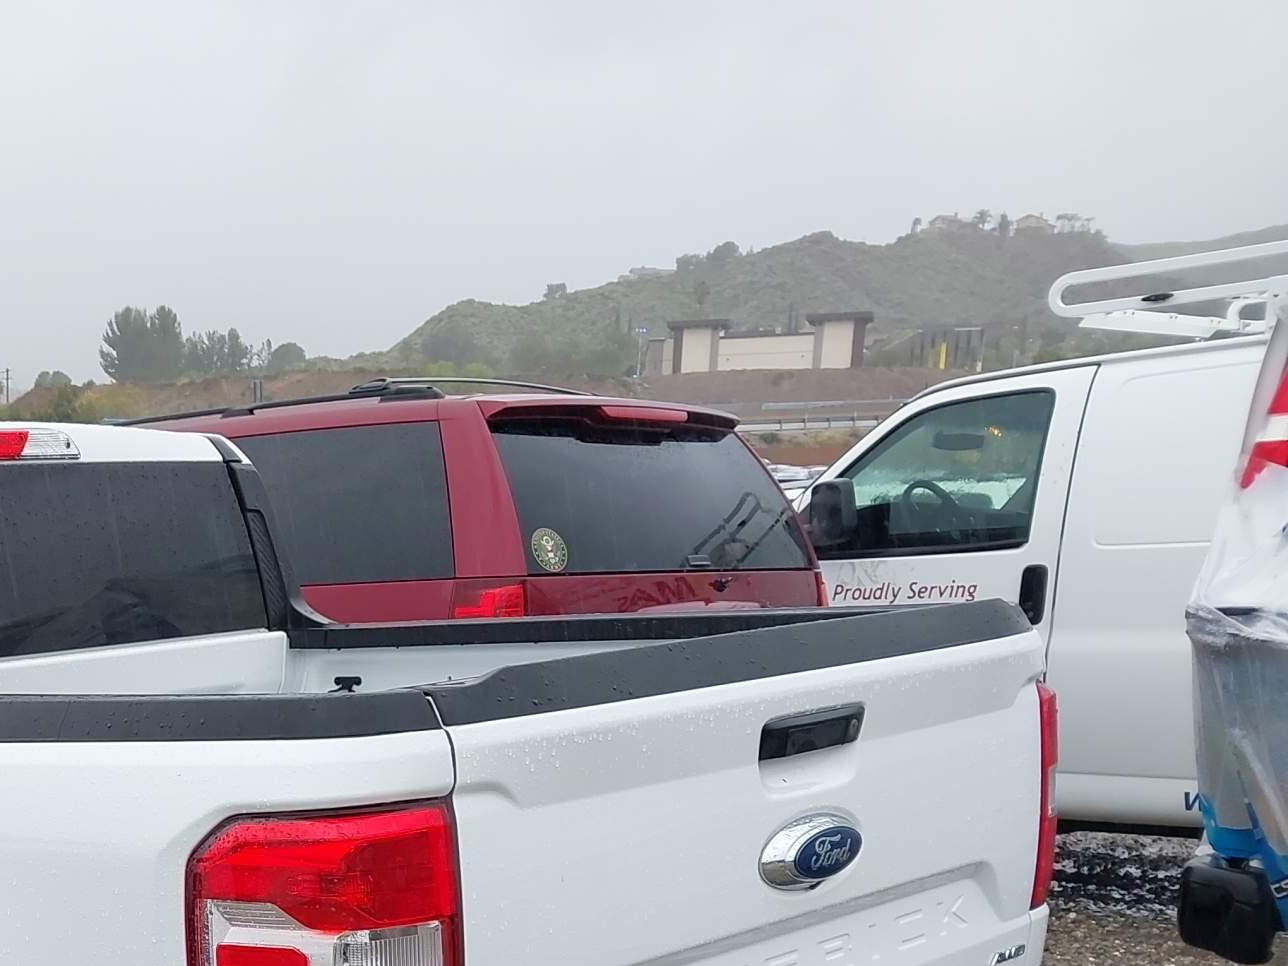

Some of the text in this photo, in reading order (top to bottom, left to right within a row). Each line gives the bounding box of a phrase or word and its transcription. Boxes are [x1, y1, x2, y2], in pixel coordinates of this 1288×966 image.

[832, 580, 978, 604] Proudly Serving
[810, 833, 852, 871] Ford
